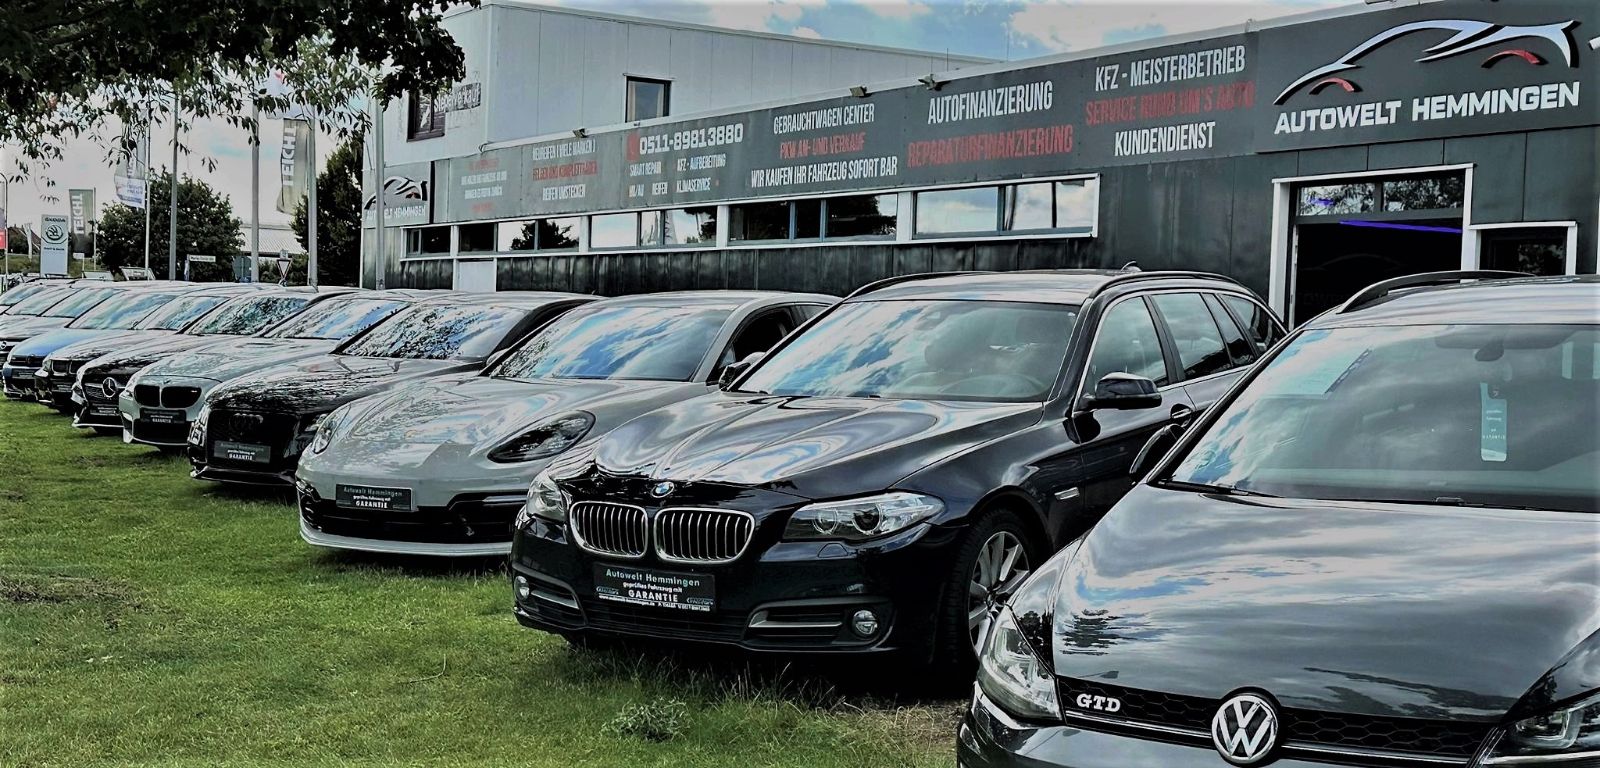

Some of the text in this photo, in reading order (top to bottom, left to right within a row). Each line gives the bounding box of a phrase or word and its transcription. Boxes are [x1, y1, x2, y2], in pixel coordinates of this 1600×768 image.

[1095, 64, 1120, 91] KFZ
[1130, 45, 1245, 87] MEISTERBETRIEB
[927, 80, 1053, 125] AUTOFINANZIERUNG
[1086, 95, 1136, 126] SERVICE
[1140, 91, 1175, 119] RUND
[1216, 80, 1256, 110] AUTO
[1274, 81, 1580, 135] AUTOWELT HEMMINGEN
[773, 103, 875, 134] GEBRAUCHTWAGEN CENTER
[639, 123, 744, 155] 0511-89813880
[829, 132, 866, 154] VERKAUF
[907, 124, 1074, 168] REPARATURFINANZIERUNG
[1114, 121, 1216, 156] KUNDENDIENST
[629, 163, 645, 177] SMART
[690, 153, 727, 170] AUFBEREITUNG
[751, 155, 898, 188] WIR KAUFEN IHR FAHRZEUG SOFORT BAR
[676, 177, 711, 193] KLIMASERVICE
[355, 500, 388, 509] GARANTIE
[606, 568, 700, 588] Autowelt Hemmingen
[628, 589, 678, 602] GARANTIE
[1076, 693, 1121, 712] GTD
